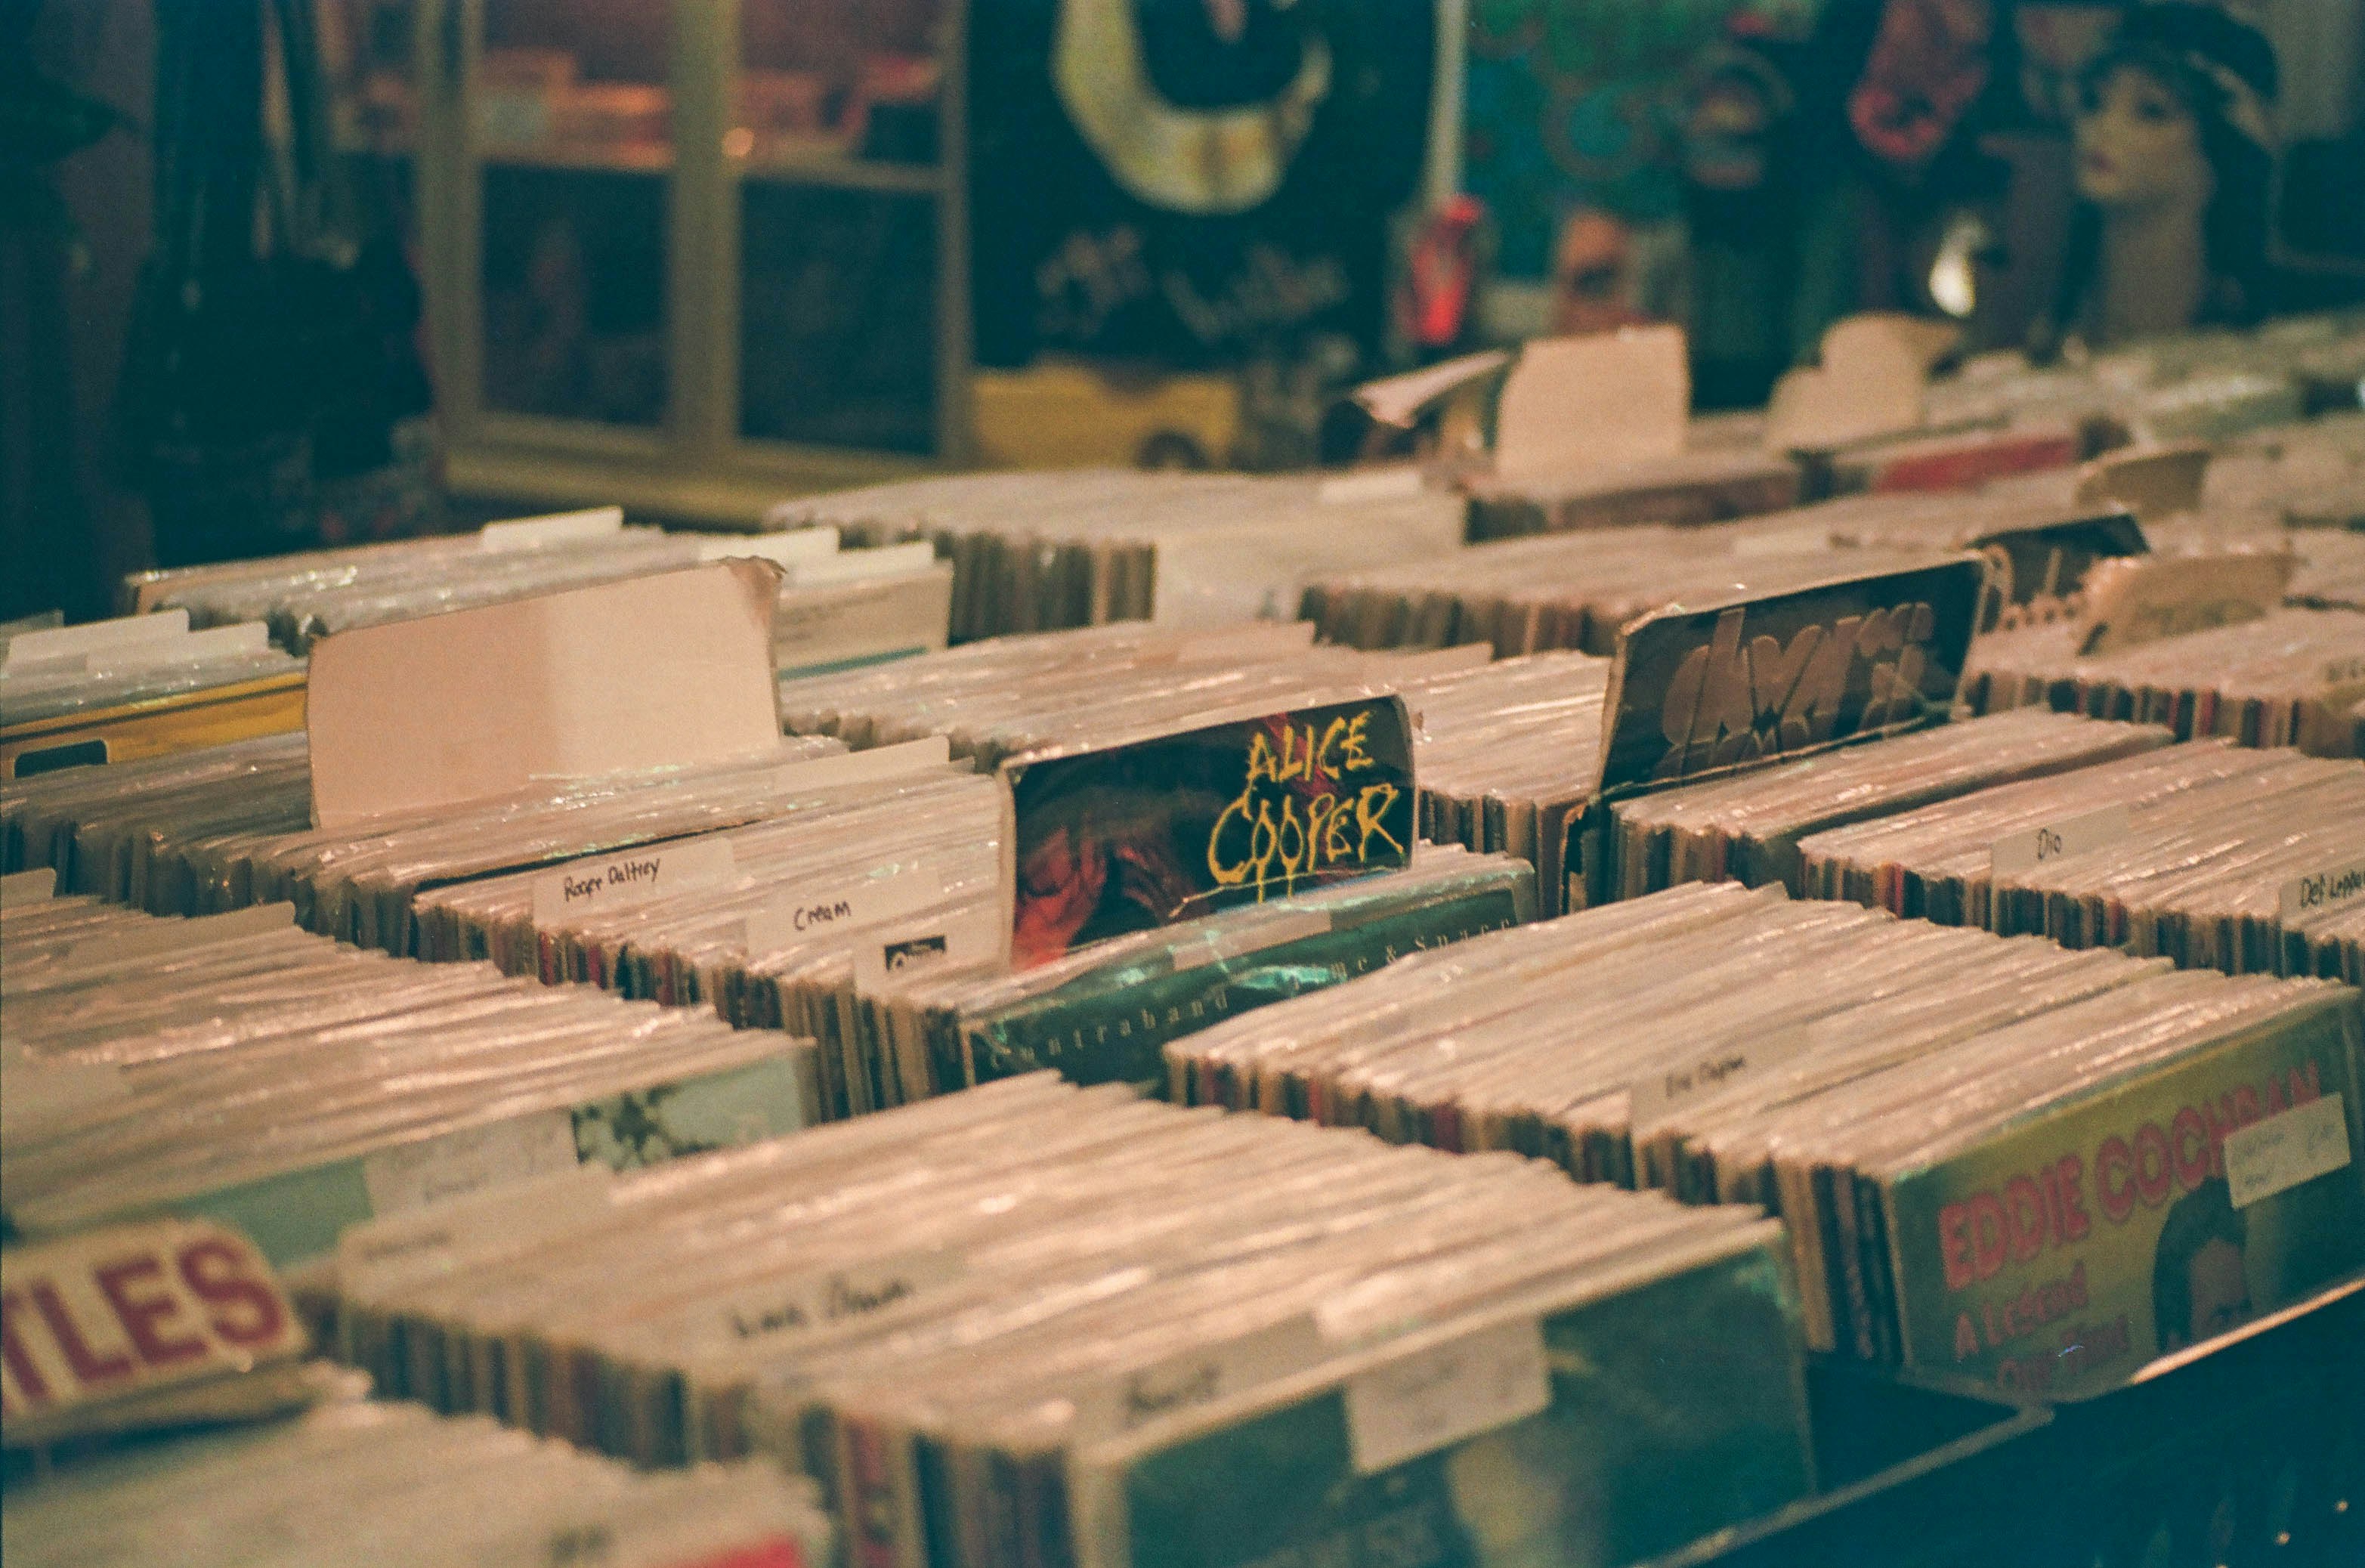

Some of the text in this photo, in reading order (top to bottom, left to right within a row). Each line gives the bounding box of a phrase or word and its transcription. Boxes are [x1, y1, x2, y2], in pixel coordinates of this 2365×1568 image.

[1246, 710, 1374, 783] ALICE
[1209, 784, 1405, 902] COOPER
[2038, 828, 2061, 859] Dio
[793, 901, 852, 931] Cream
[2300, 873, 2325, 908] Def
[1938, 1155, 2091, 1291] EDDIE
